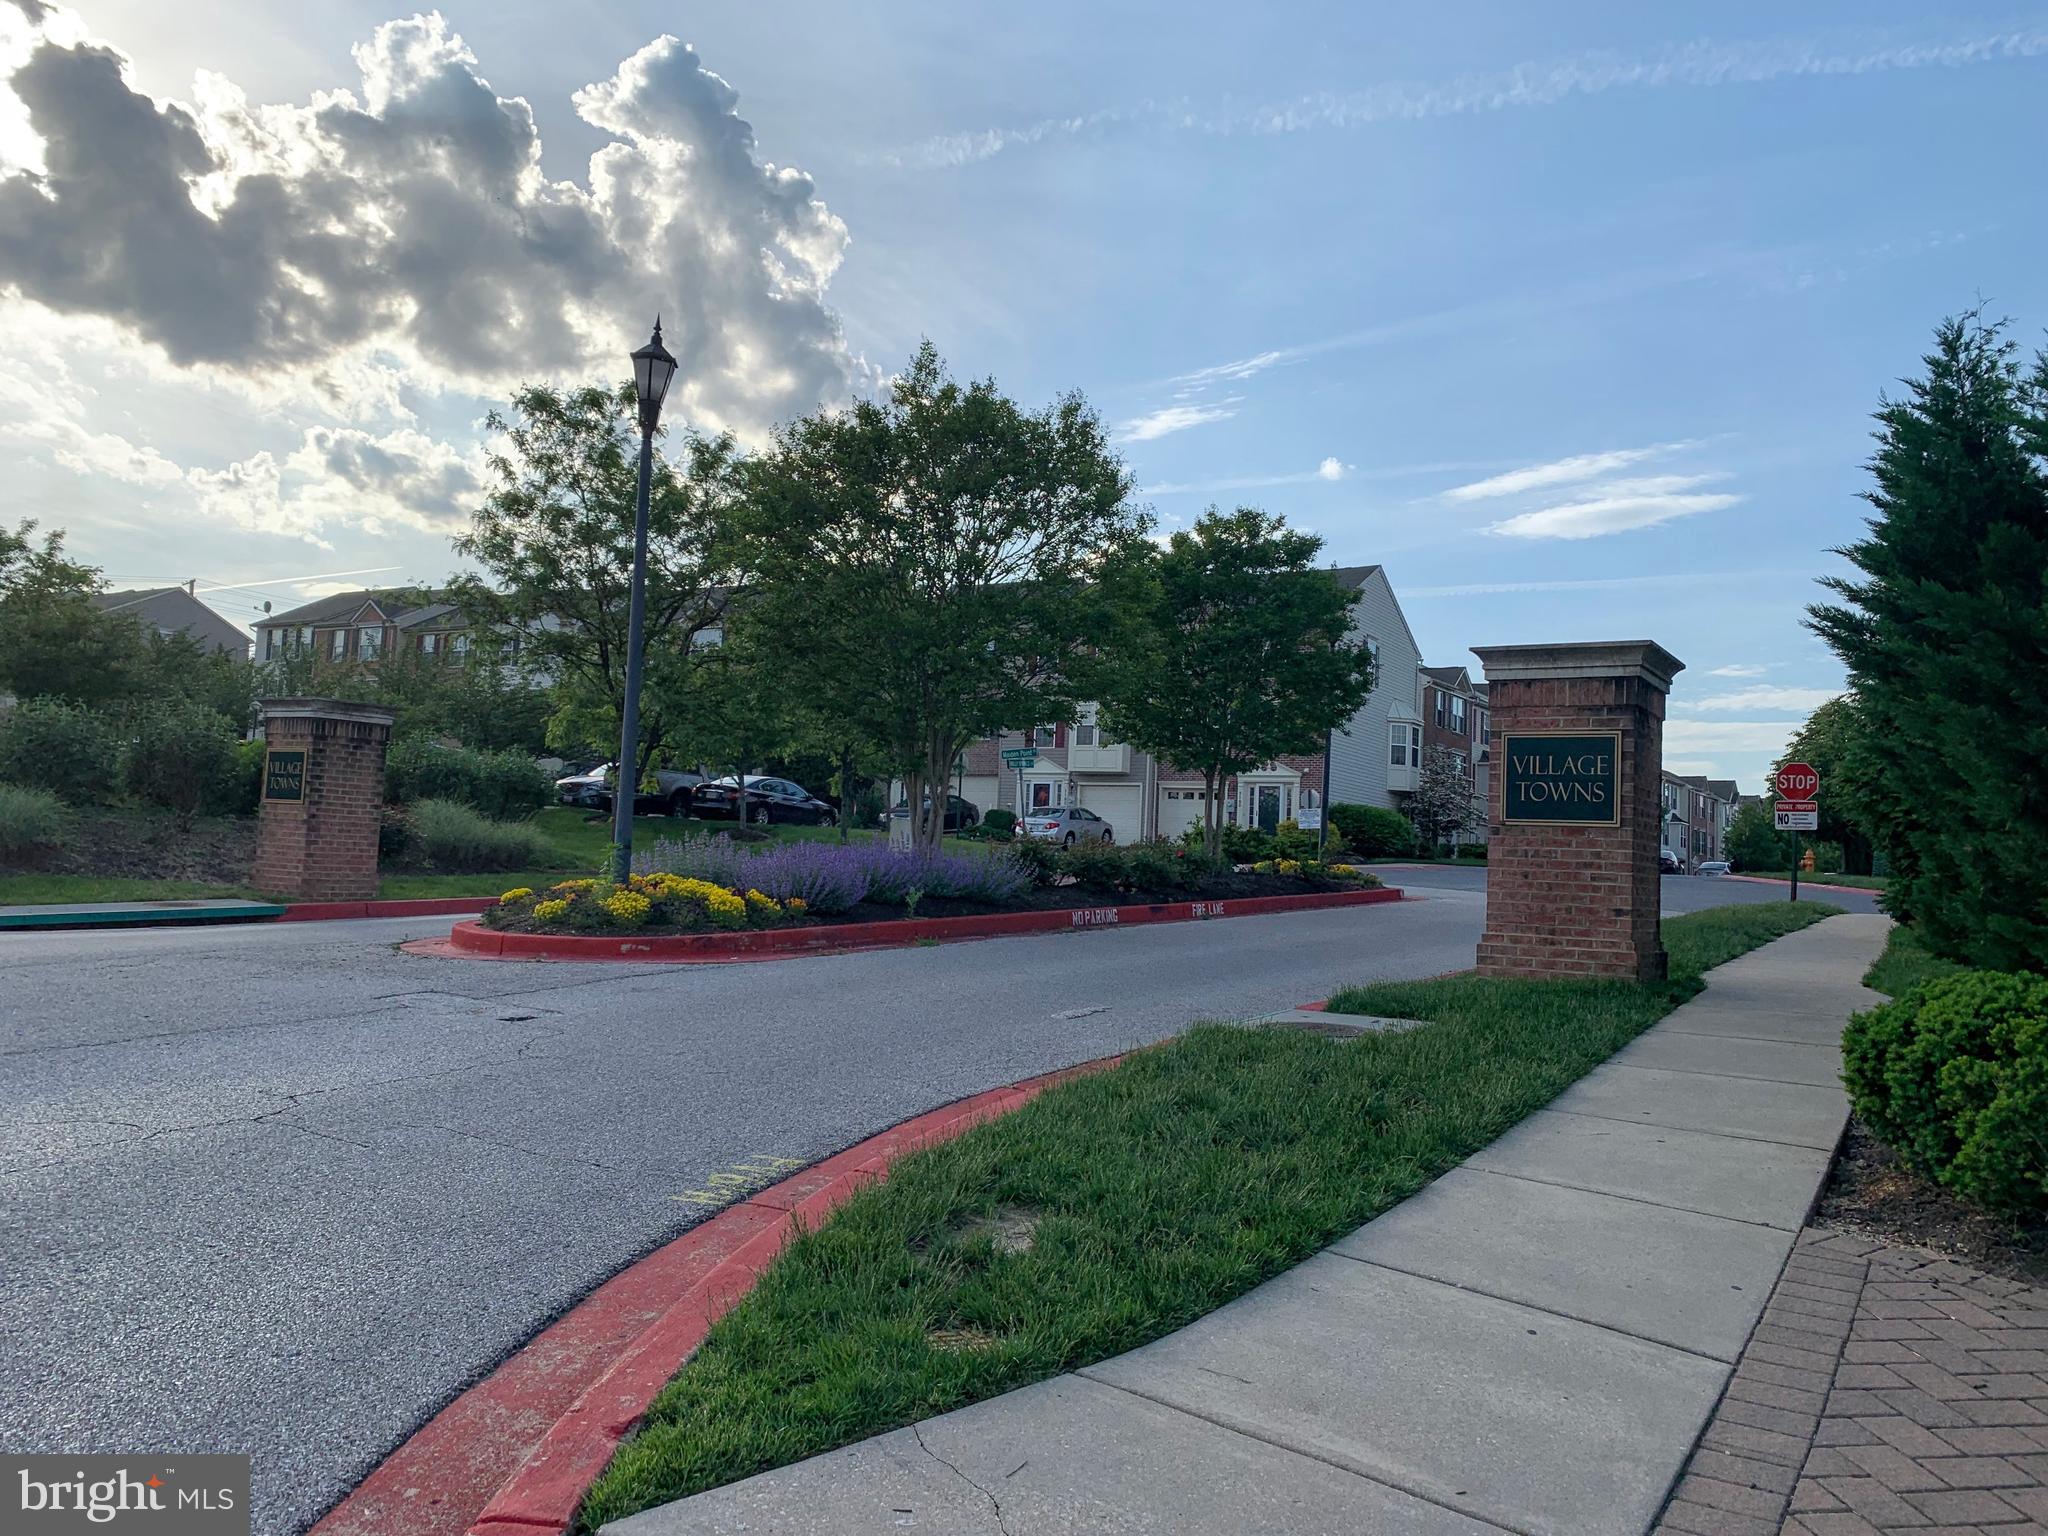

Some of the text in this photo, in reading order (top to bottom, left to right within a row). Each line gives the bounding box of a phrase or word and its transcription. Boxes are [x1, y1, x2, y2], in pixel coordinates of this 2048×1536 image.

[1020, 749, 1033, 757] Point
[270, 761, 302, 774] VILLAGE
[1512, 754, 1609, 775] VILLAGE
[270, 777, 299, 790] TOWNS
[1779, 774, 1815, 790] STOP
[1516, 781, 1605, 802] TOWNS
[1795, 803, 1816, 811] PROPERTY
[1777, 813, 1790, 825] NO
[1192, 902, 1224, 917] FIRE LANE
[1072, 909, 1118, 926] NO PARKING
